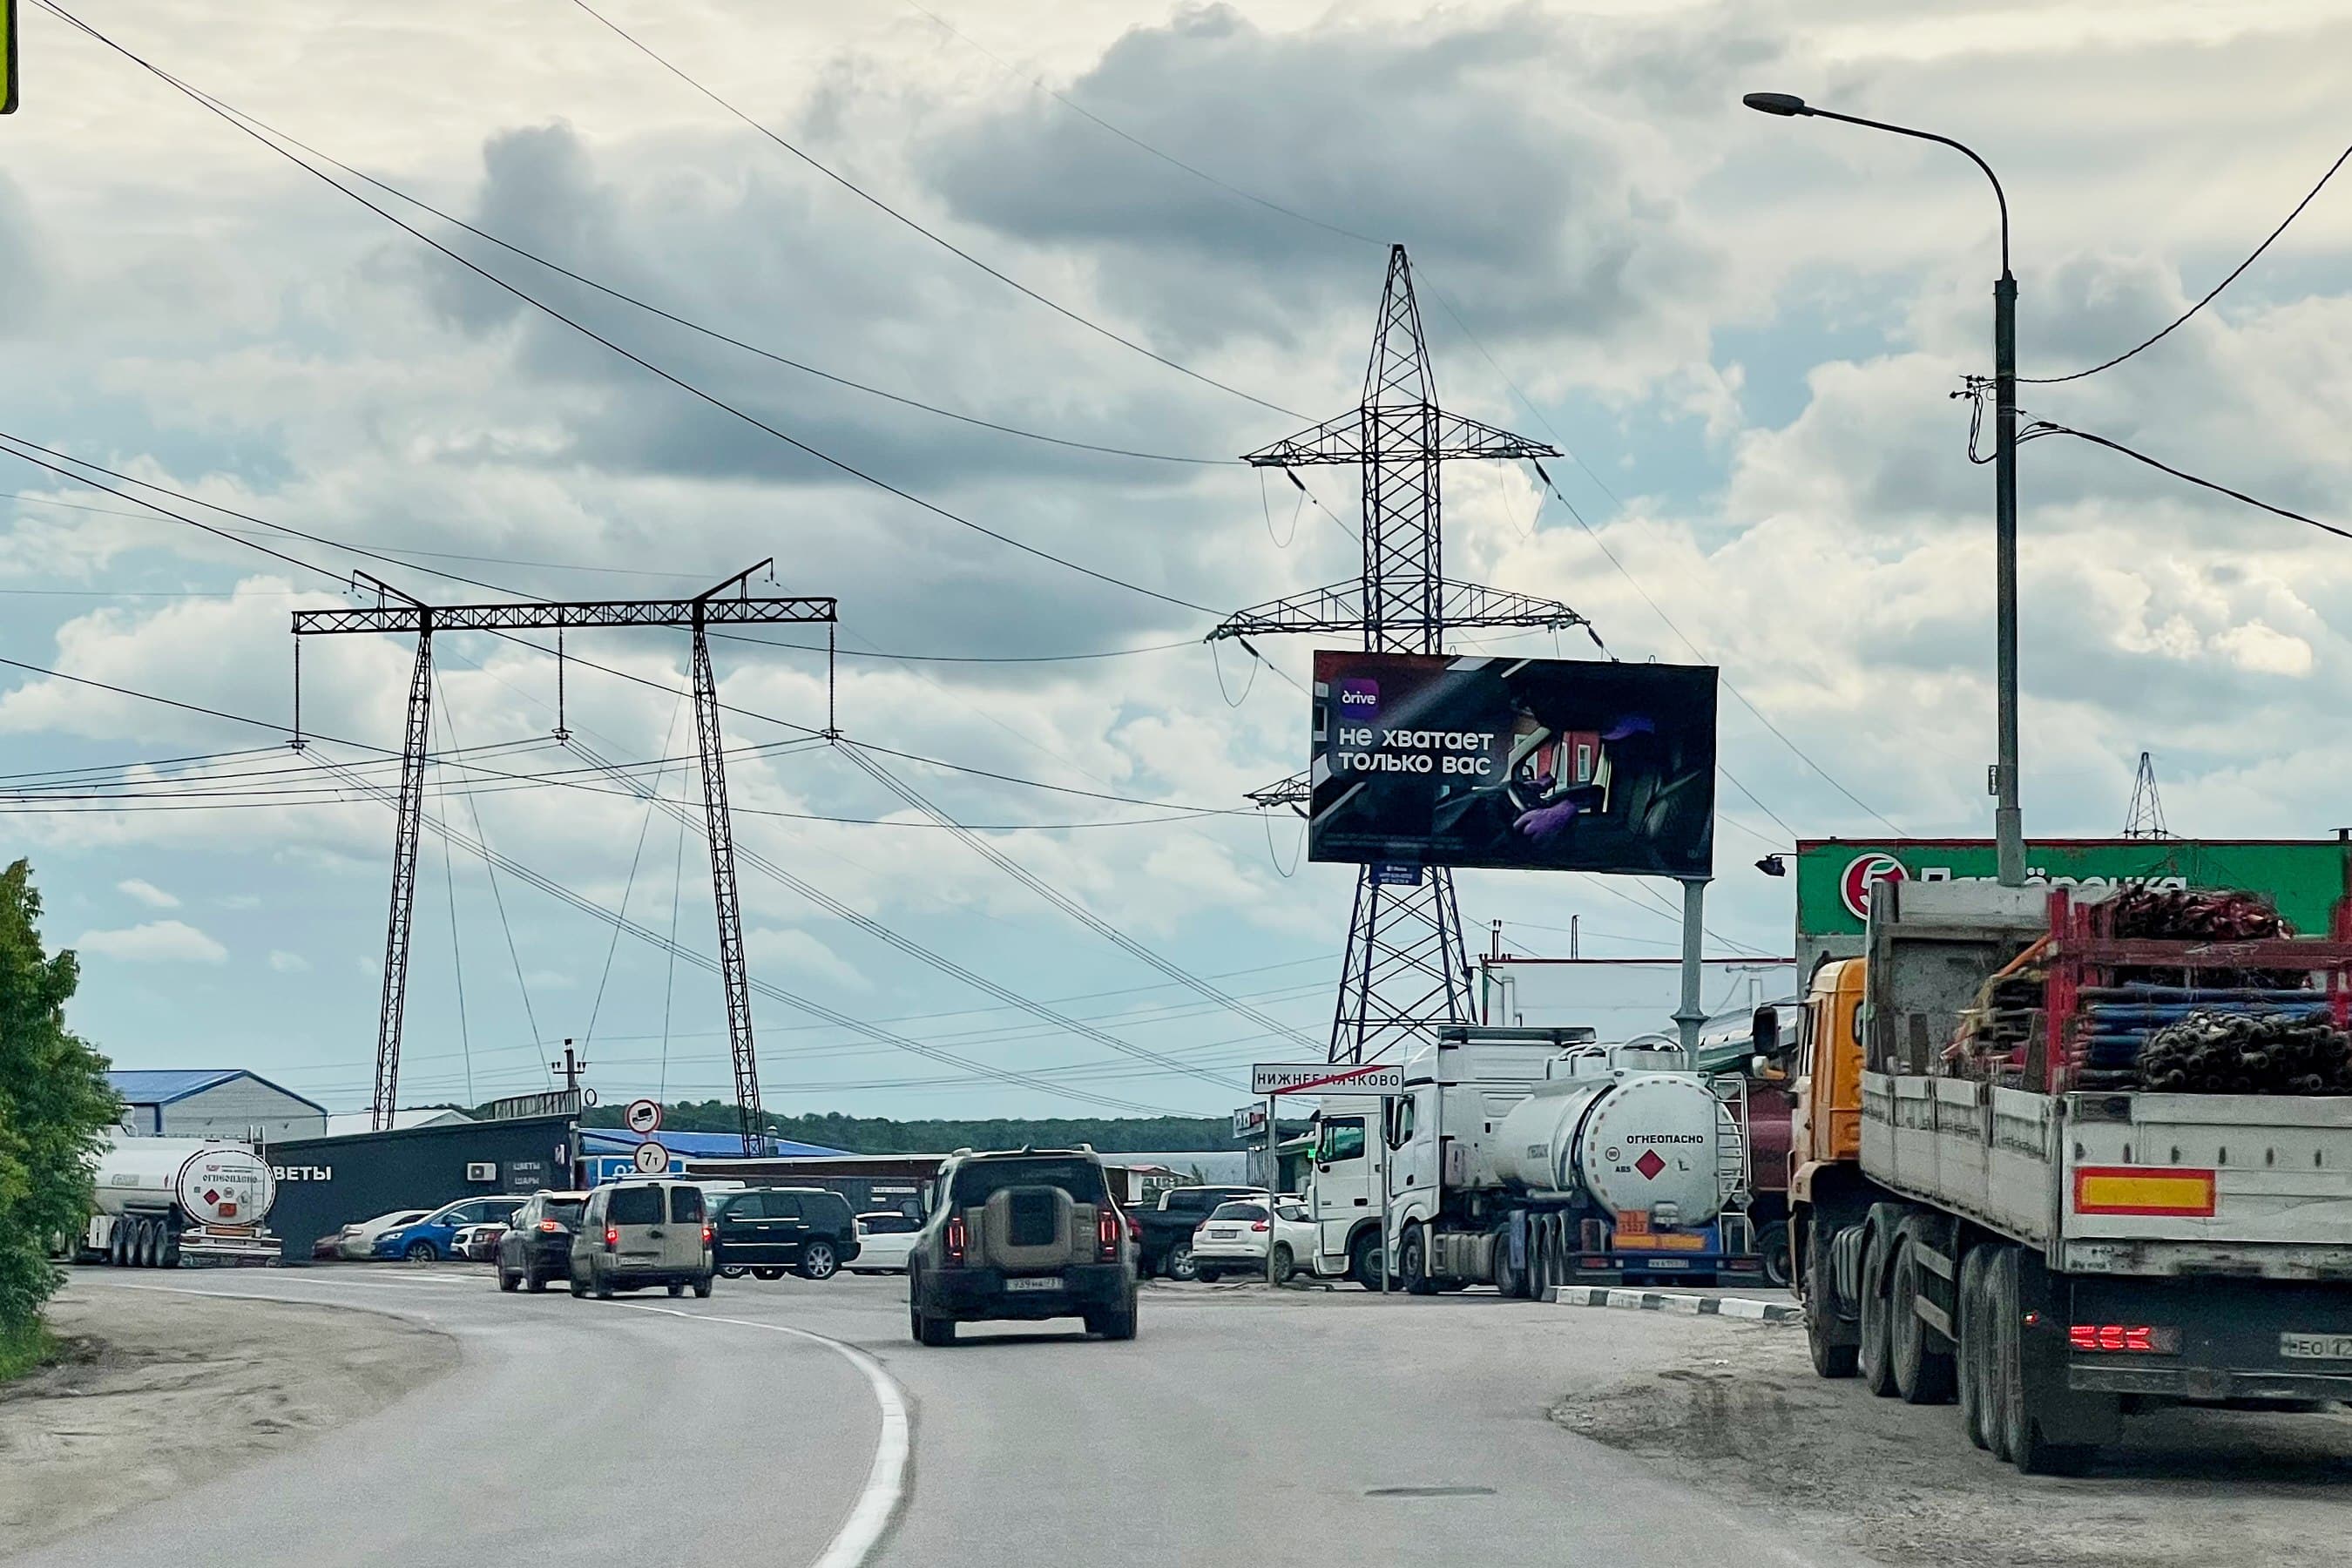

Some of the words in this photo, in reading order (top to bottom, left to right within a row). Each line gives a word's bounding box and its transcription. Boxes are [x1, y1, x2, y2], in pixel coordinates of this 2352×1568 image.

[1339, 727, 1373, 747] не
[1382, 729, 1494, 751] хватает
[1338, 752, 1433, 774] только
[1442, 755, 1491, 775] вас
[1626, 1134, 1704, 1145] ОГНЕОПАСНО
[273, 1166, 332, 1180] ВЕТЫ
